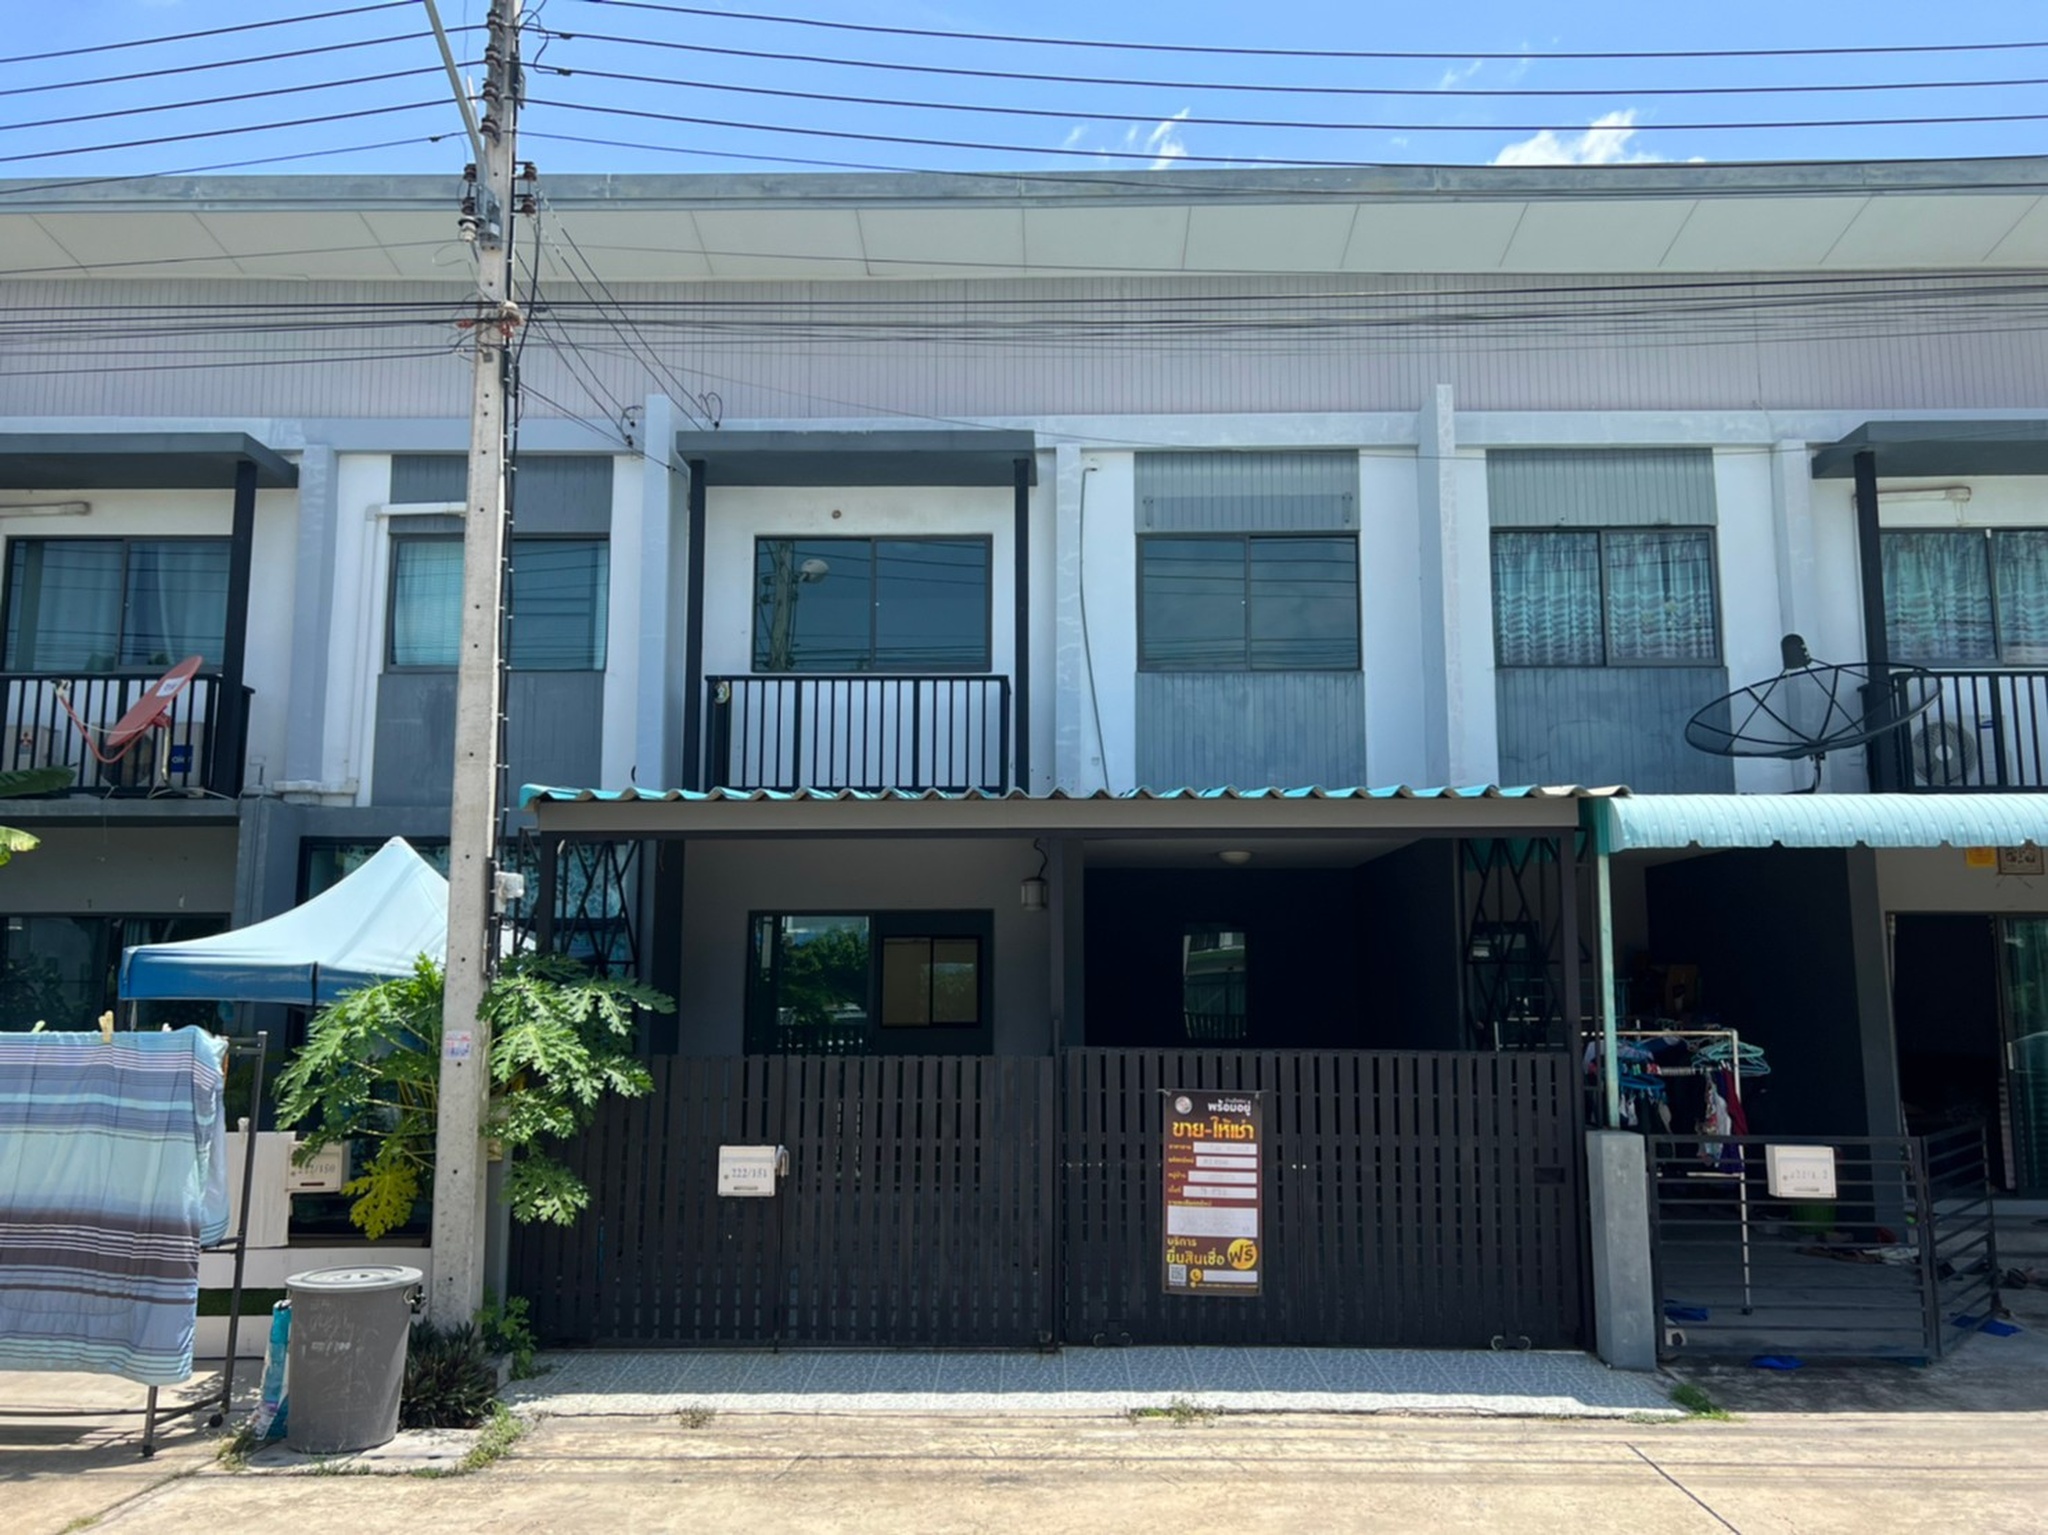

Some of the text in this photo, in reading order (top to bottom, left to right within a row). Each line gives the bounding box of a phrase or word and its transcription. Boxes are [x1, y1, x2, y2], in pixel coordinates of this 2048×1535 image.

[1207, 1099, 1251, 1117] พร้อมอยู่
[1172, 1116, 1254, 1140] ขาย-ให้เช่า
[1167, 1237, 1197, 1247] บริการ
[1229, 1240, 1254, 1264] ฟรี
[1166, 1246, 1225, 1266] ยื่นสินเชื่อ
